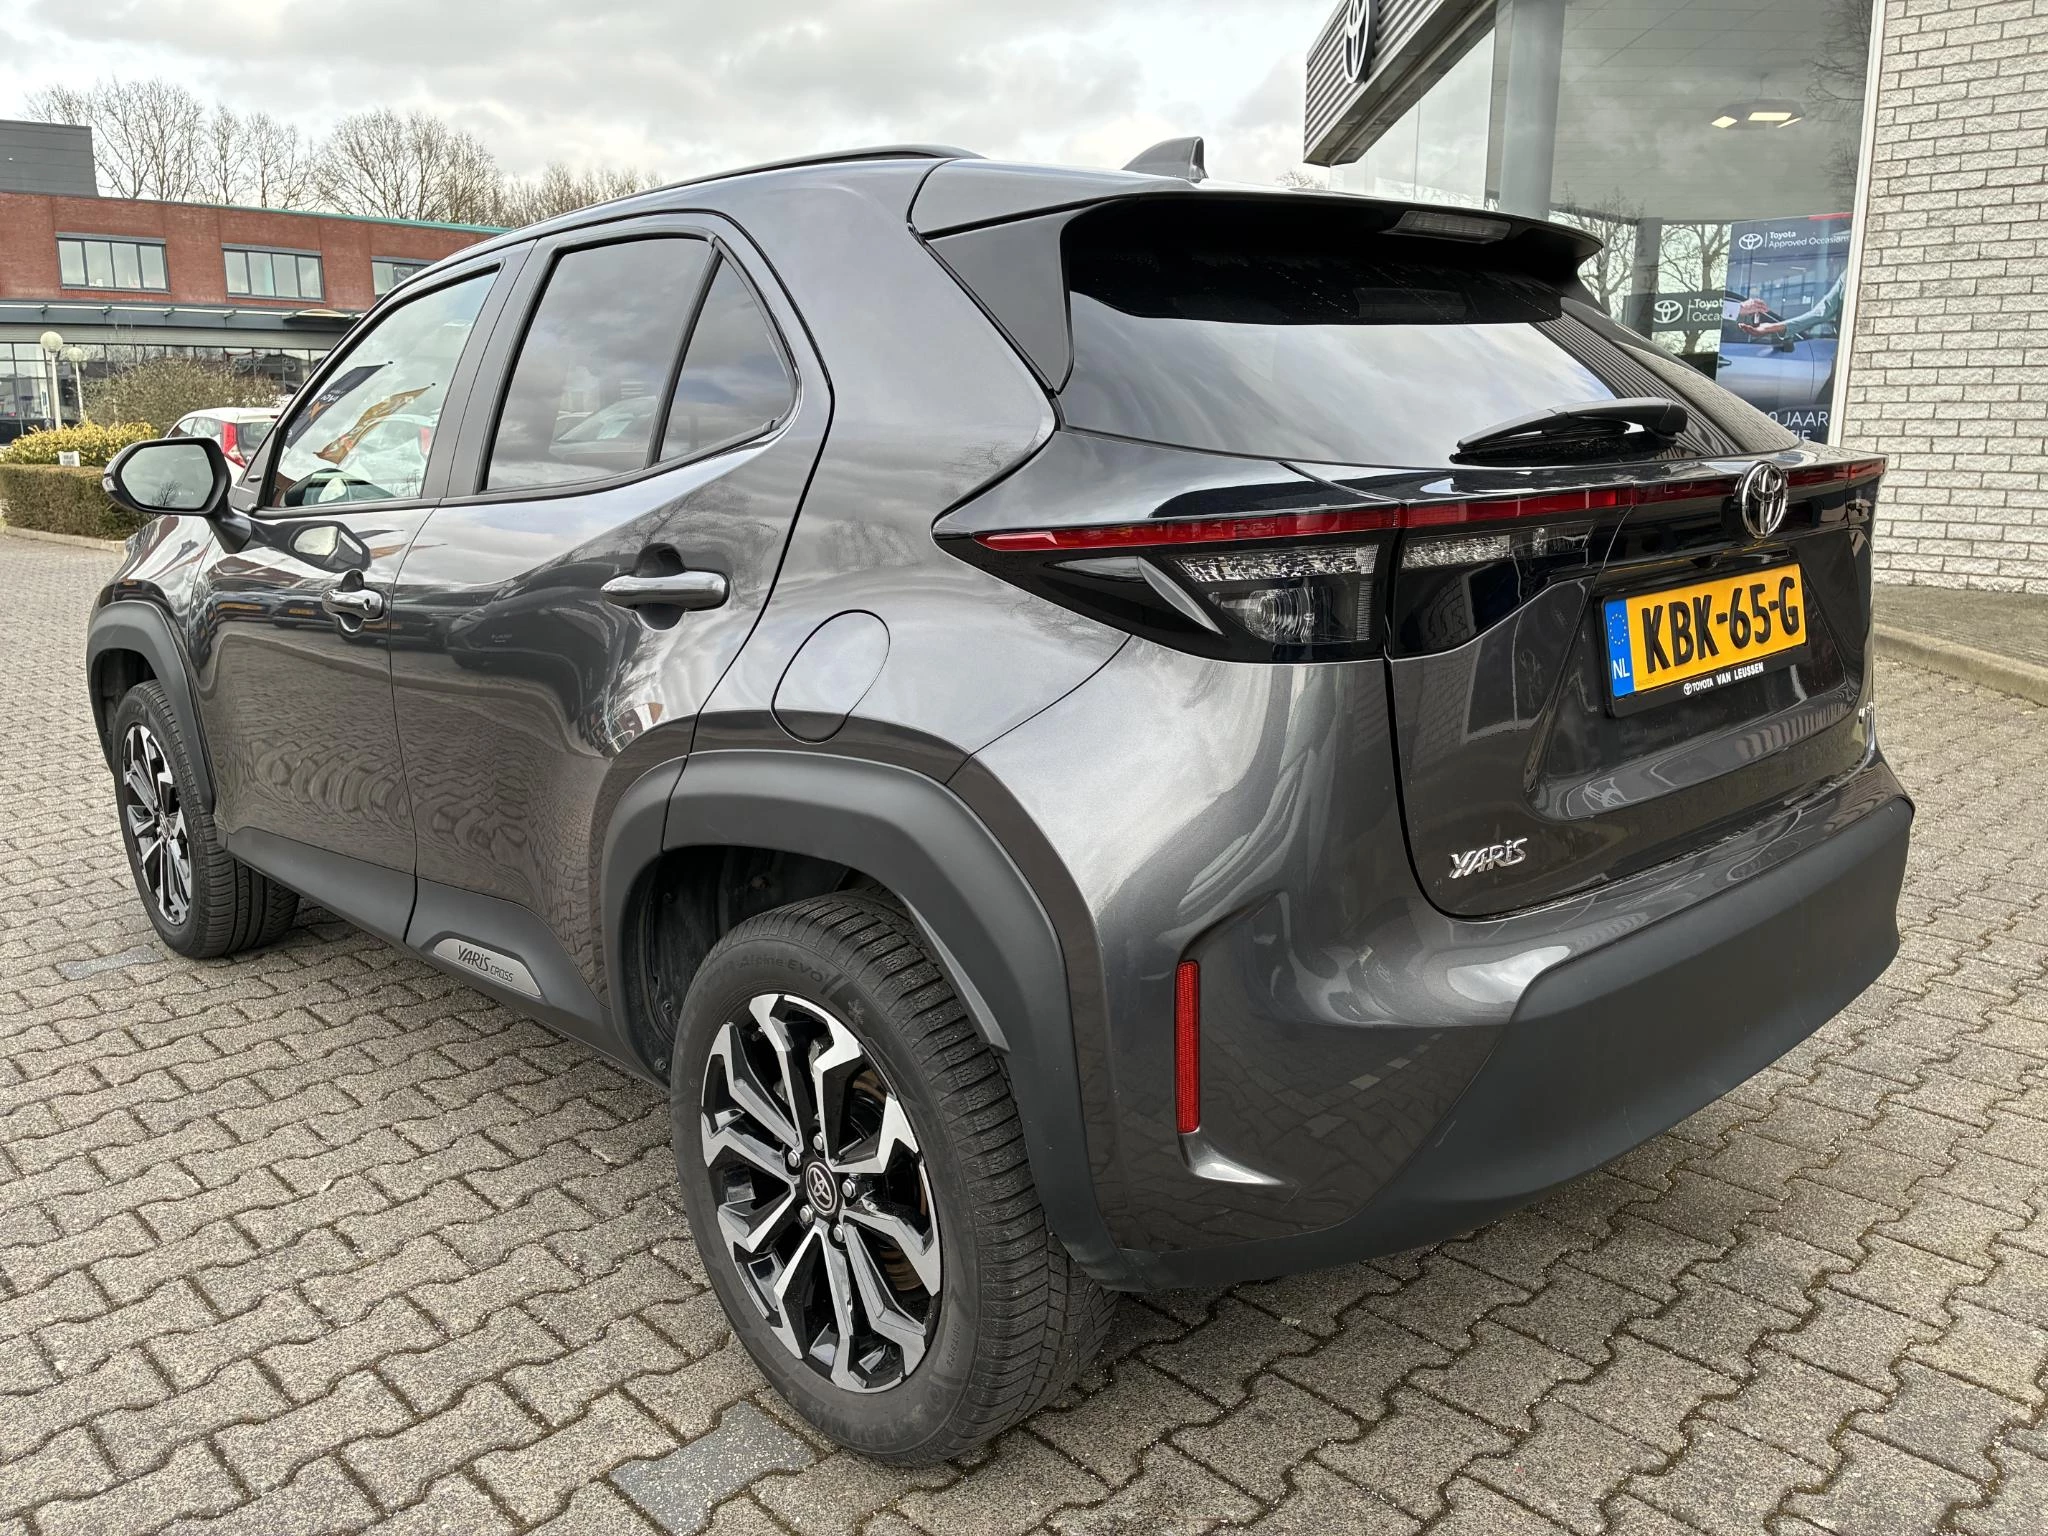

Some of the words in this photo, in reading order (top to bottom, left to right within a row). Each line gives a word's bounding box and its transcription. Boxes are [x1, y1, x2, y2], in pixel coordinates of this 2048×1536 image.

[1768, 237, 1807, 249] Approved
[1769, 231, 1797, 240] Toyota
[1693, 298, 1724, 311] Toyot
[1783, 411, 1829, 427] JAAR
[1641, 576, 1800, 674] KBK-65-G
[1612, 656, 1630, 680] NL
[1691, 677, 1714, 692] TOYOTA
[1716, 671, 1732, 686] VAN
[1733, 661, 1764, 681] LEUSSEN
[489, 964, 514, 983] CROSS
